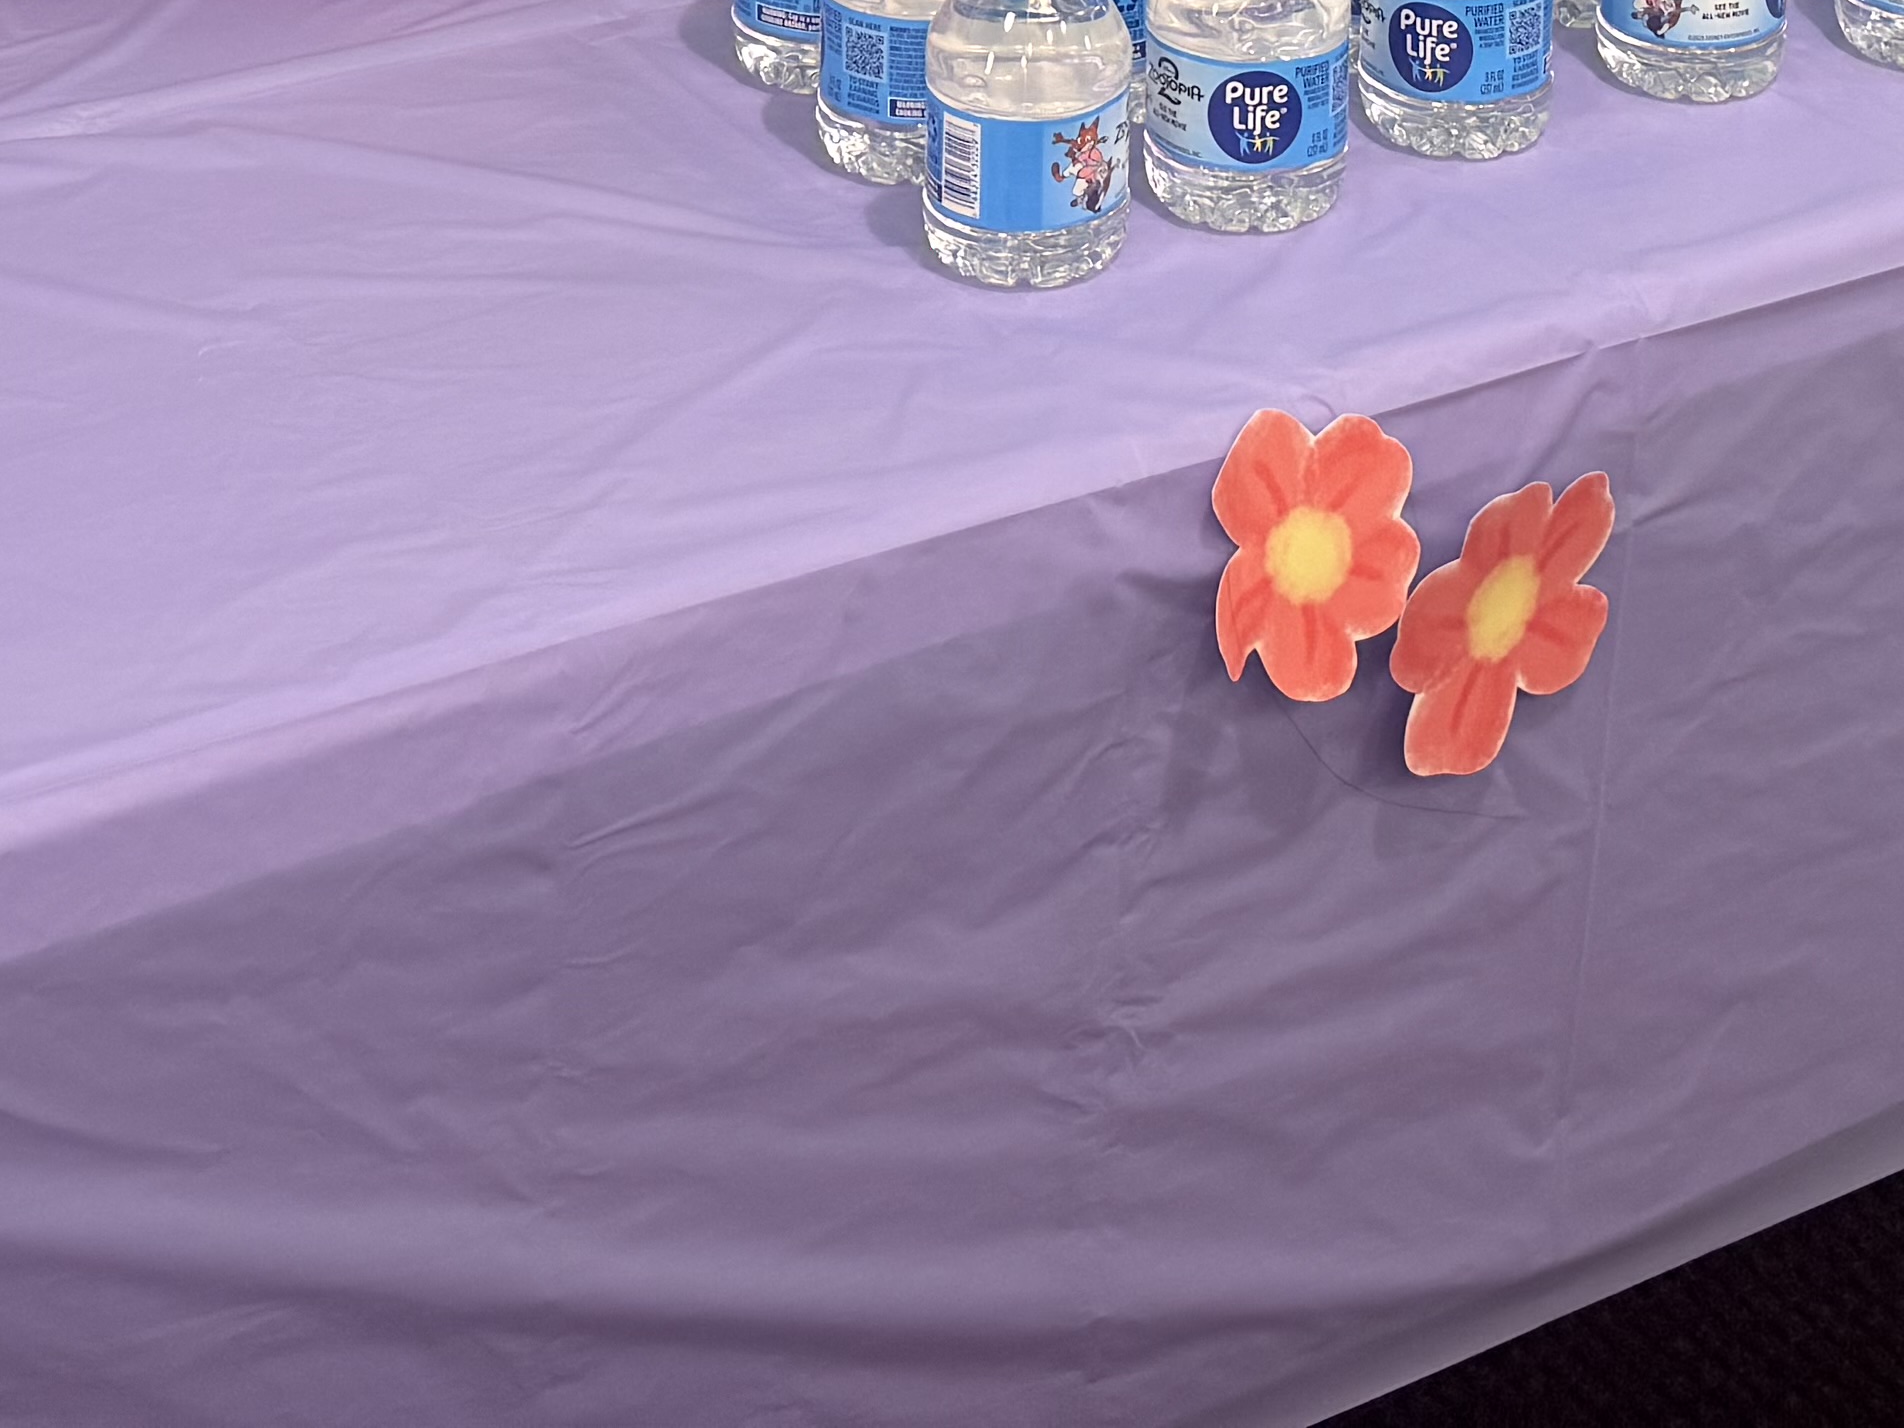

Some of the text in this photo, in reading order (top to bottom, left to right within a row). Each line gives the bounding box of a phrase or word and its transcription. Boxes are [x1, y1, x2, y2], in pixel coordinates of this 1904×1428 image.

[1466, 4, 1504, 17] PURIFIED
[1400, 9, 1459, 39] Pure
[1474, 15, 1504, 28] WATER
[1406, 34, 1450, 65] Life
[1295, 60, 1330, 78] PURIFIED
[1303, 72, 1330, 88] WATER
[1226, 81, 1289, 105] Pure
[1233, 105, 1281, 135] Life
